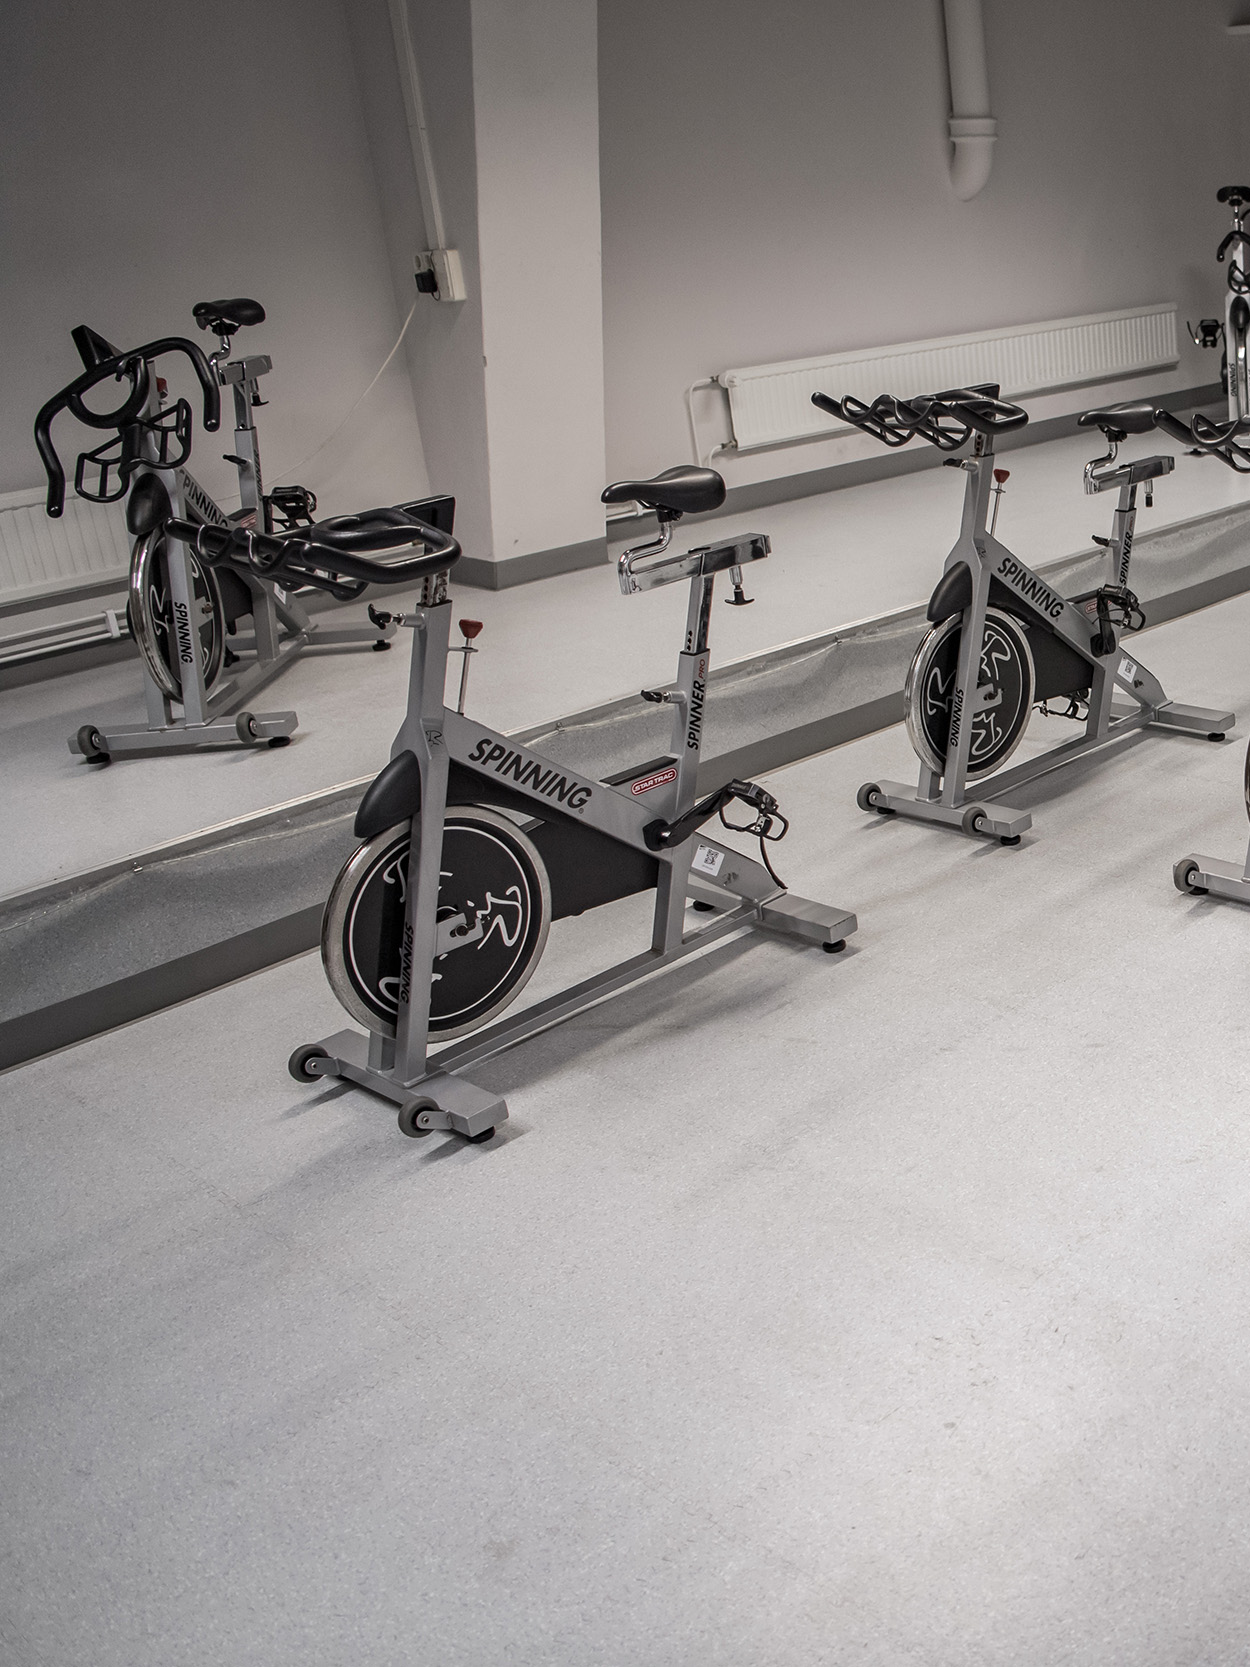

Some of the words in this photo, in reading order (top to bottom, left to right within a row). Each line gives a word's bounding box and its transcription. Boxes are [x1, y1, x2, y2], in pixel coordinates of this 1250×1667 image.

[997, 557, 1064, 618] SPINNING
[1120, 532, 1133, 586] SPINNER
[174, 601, 193, 664] SPINNING
[687, 680, 706, 750] SPINNER
[698, 659, 706, 679] PRO
[950, 686, 964, 747] SPINNING
[468, 738, 592, 809] SPINNING
[634, 780, 654, 792] STAR
[654, 771, 674, 784] TRAC
[400, 921, 414, 1004] SPINNING
